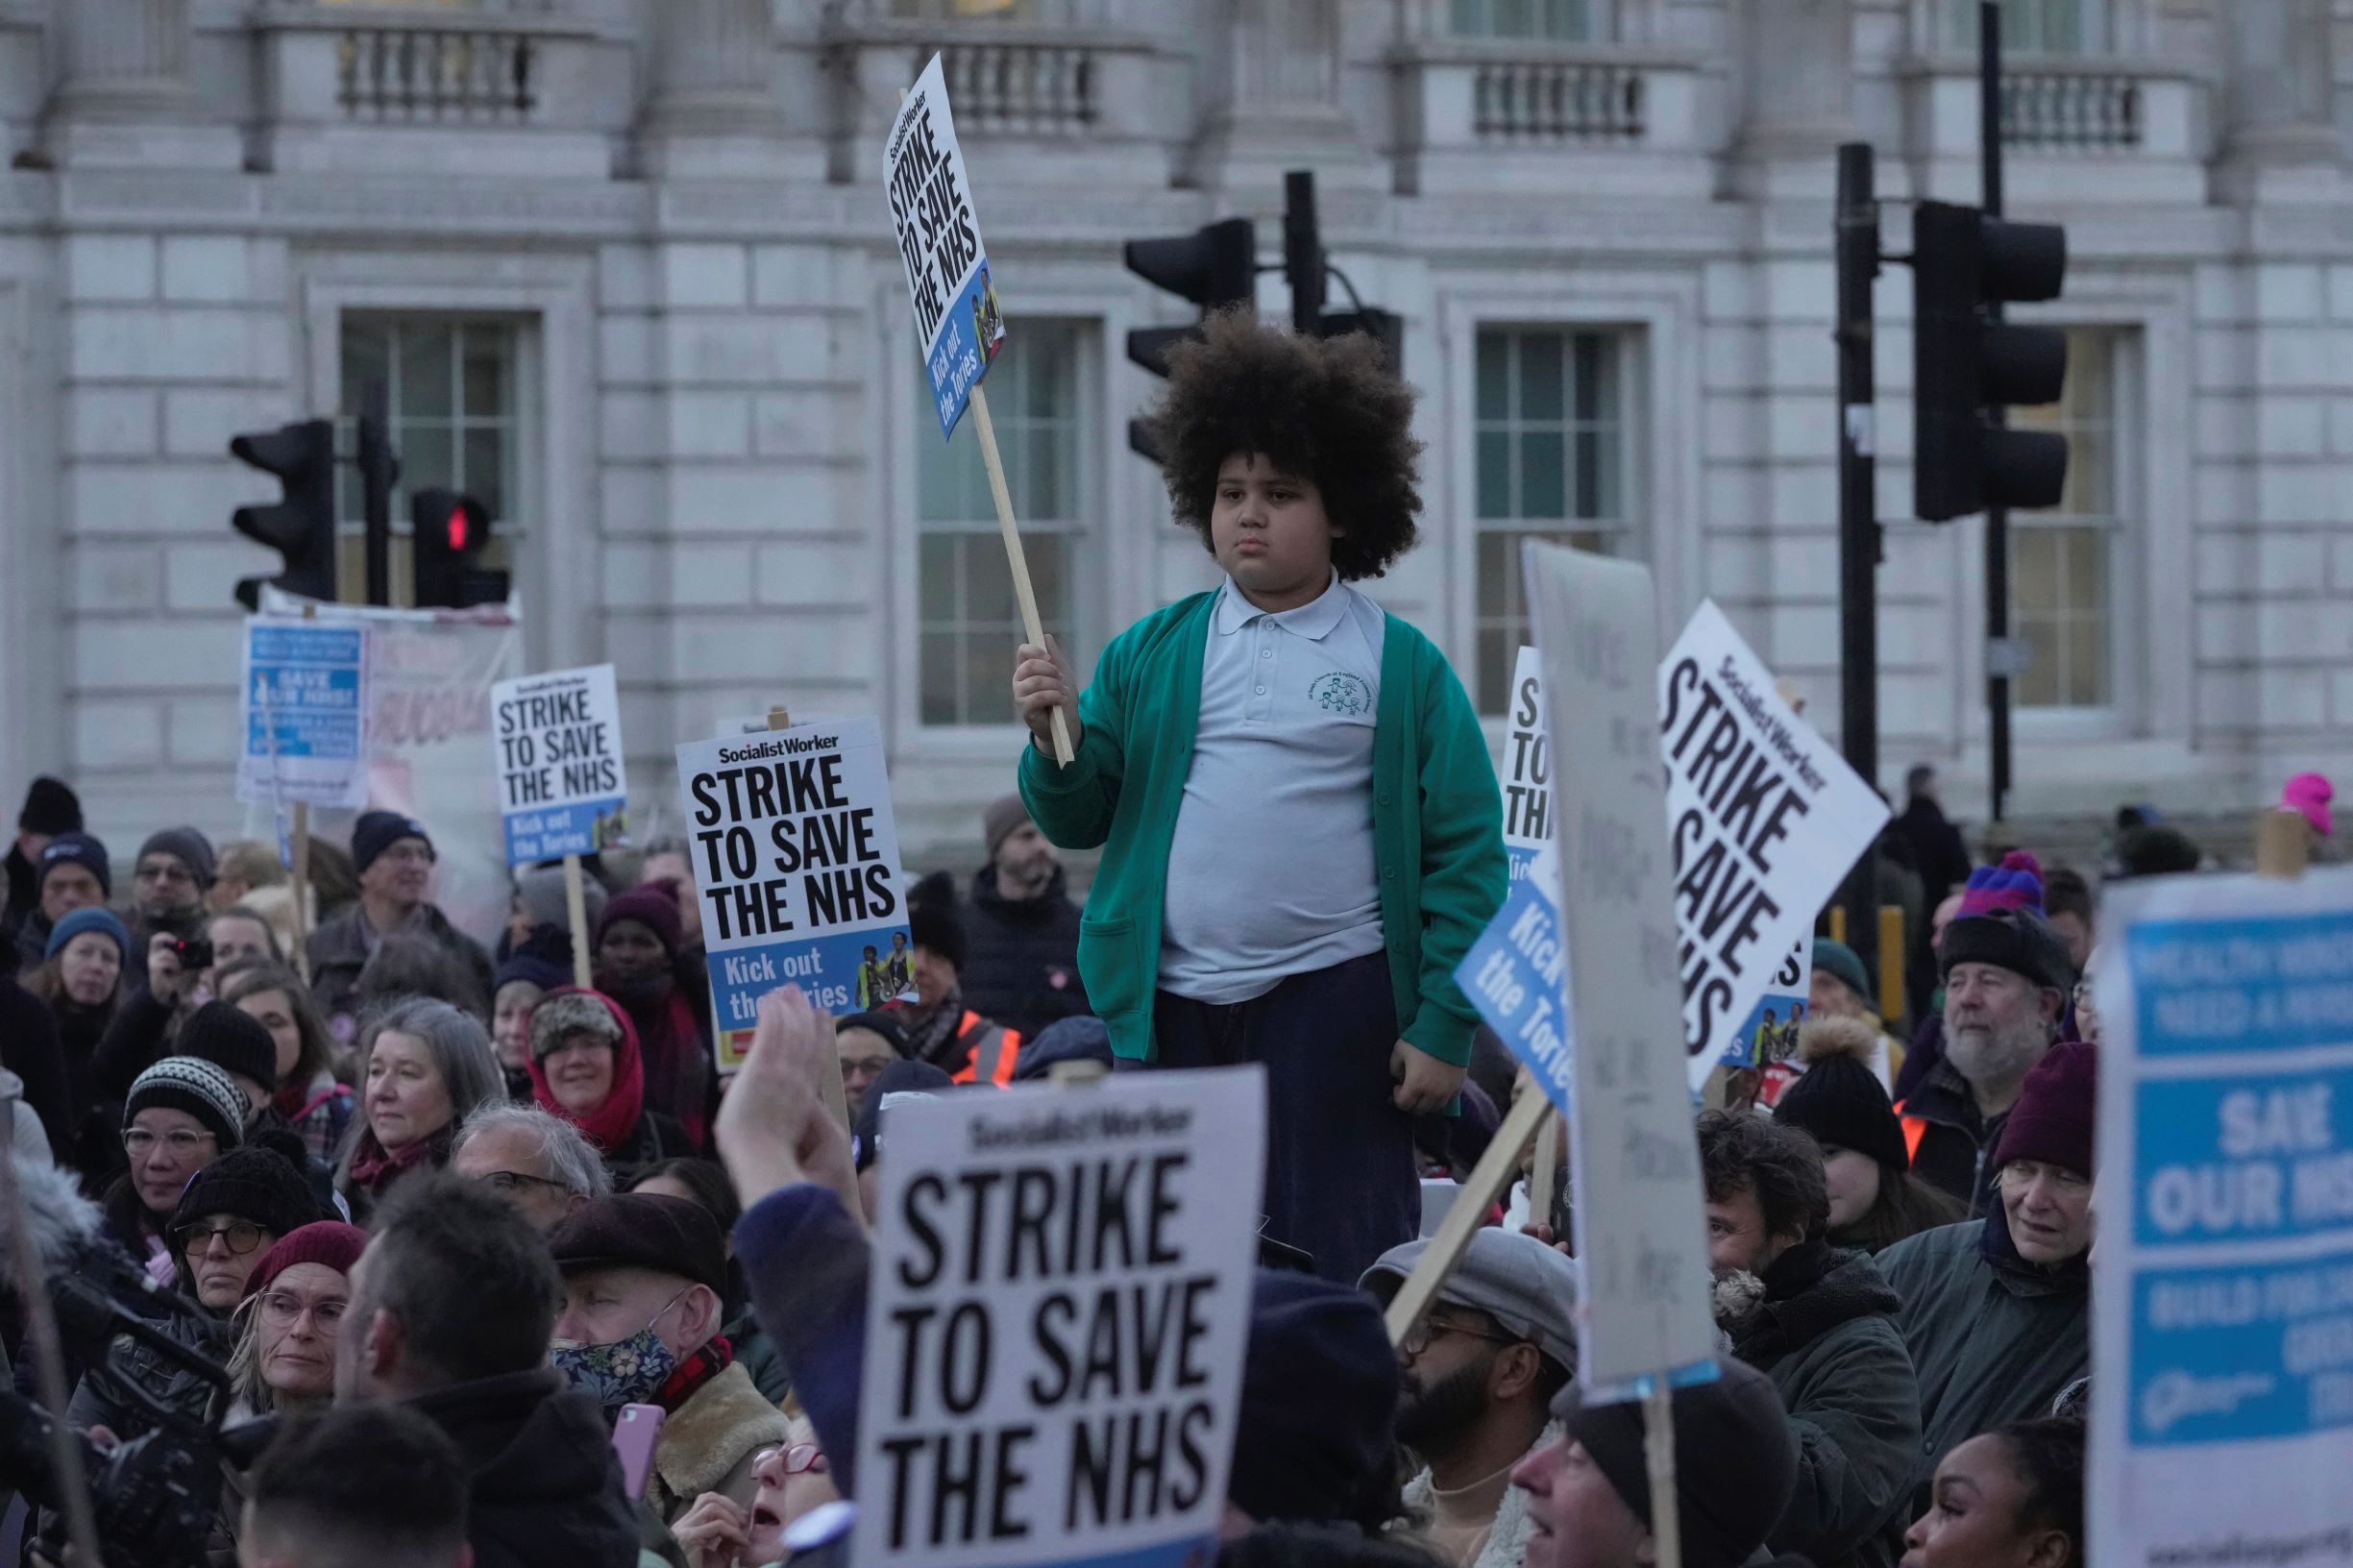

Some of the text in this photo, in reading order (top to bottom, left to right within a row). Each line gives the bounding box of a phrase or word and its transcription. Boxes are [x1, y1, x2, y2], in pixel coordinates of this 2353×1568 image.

[889, 110, 942, 235] STRIKE
[901, 150, 963, 290] TO SAVE
[914, 204, 978, 347] THE NHS
[931, 318, 961, 390] Kick out
[940, 347, 978, 428] the Tories
[499, 689, 591, 734] STRIKE
[1338, 671, 1360, 681] England
[502, 723, 609, 770] TO SAVE
[504, 758, 618, 806] THE NHS
[1512, 730, 1551, 786] TO
[1661, 657, 1810, 874] STRIKE
[691, 754, 849, 826] STRIKE
[1506, 784, 1555, 841] TH
[697, 807, 881, 883] TO SAVE
[706, 864, 895, 941] THE NHS
[1674, 808, 1781, 978] SAVE
[724, 946, 823, 986] Kick out
[1475, 948, 1574, 1090] the Torie
[898, 1153, 1191, 1290] STRIKE
[2148, 1161, 2284, 1235] OUR
[892, 1273, 1217, 1420] TO SAVE
[880, 1400, 1214, 1552] THE NHS
